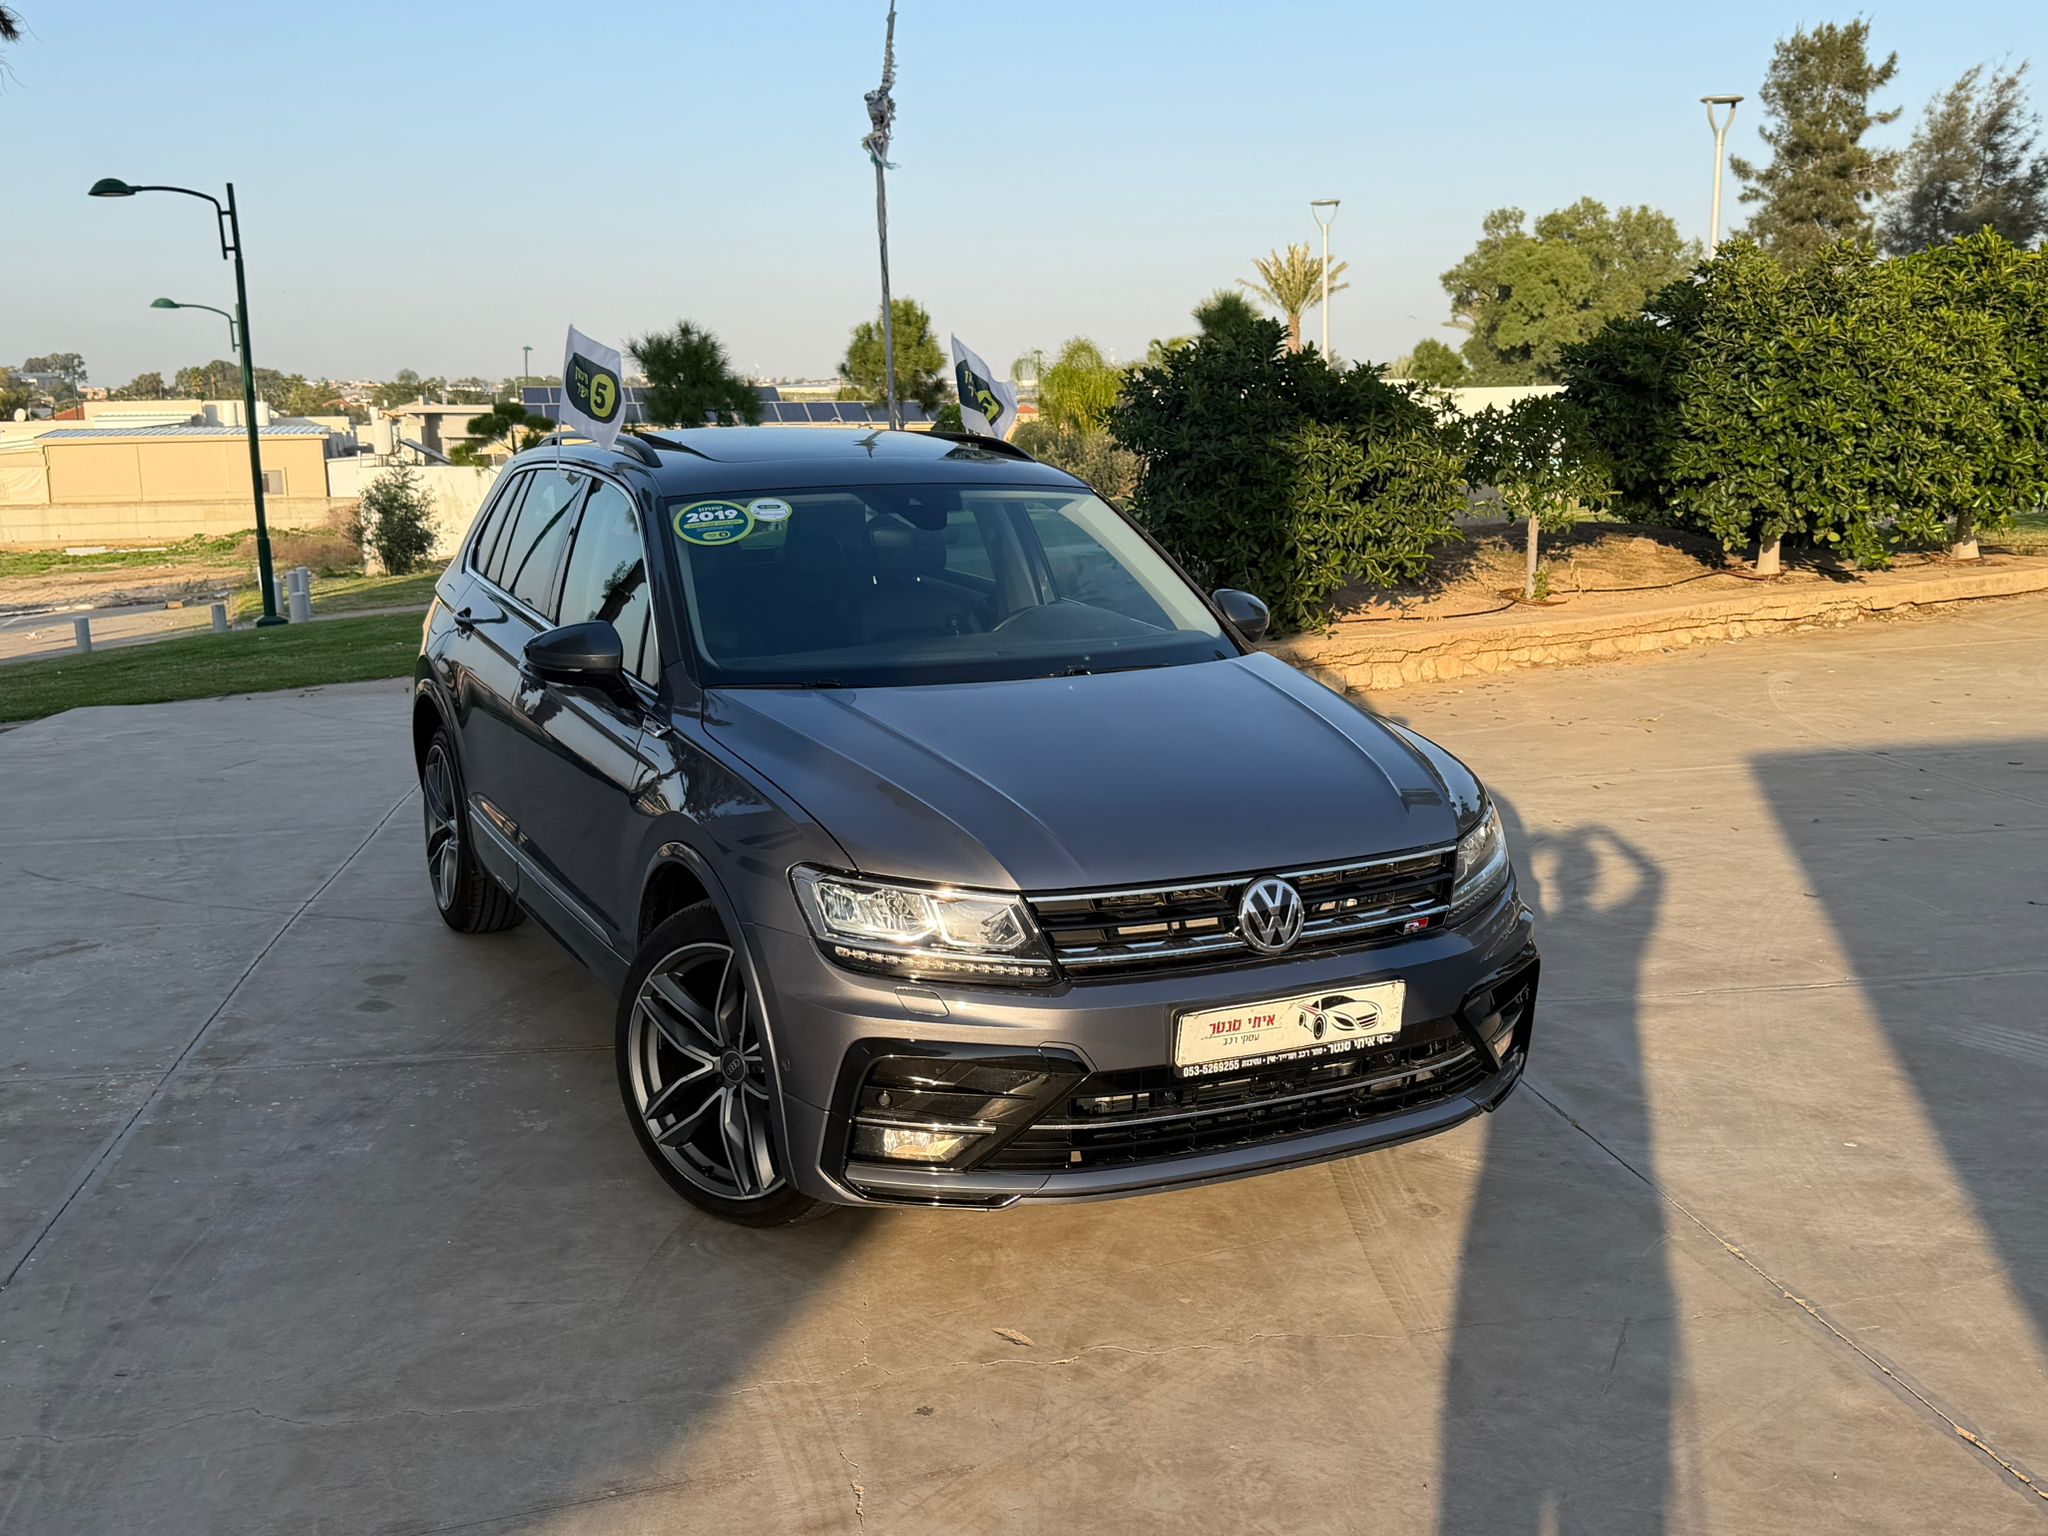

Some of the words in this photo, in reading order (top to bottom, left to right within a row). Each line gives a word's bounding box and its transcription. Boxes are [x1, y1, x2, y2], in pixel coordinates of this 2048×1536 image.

[593, 381, 608, 410] 5
[686, 509, 738, 523] 2019
[1209, 1018, 1242, 1036] סנטר
[1248, 1014, 1276, 1029] איתי
[1222, 1037, 1238, 1046] רכב
[1240, 1033, 1260, 1045] עסקי
[1354, 1036, 1375, 1049] איתי
[1327, 1039, 1351, 1054] סנטר
[1298, 1050, 1310, 1058] רכב
[1183, 1060, 1240, 1077] 053-5269255
